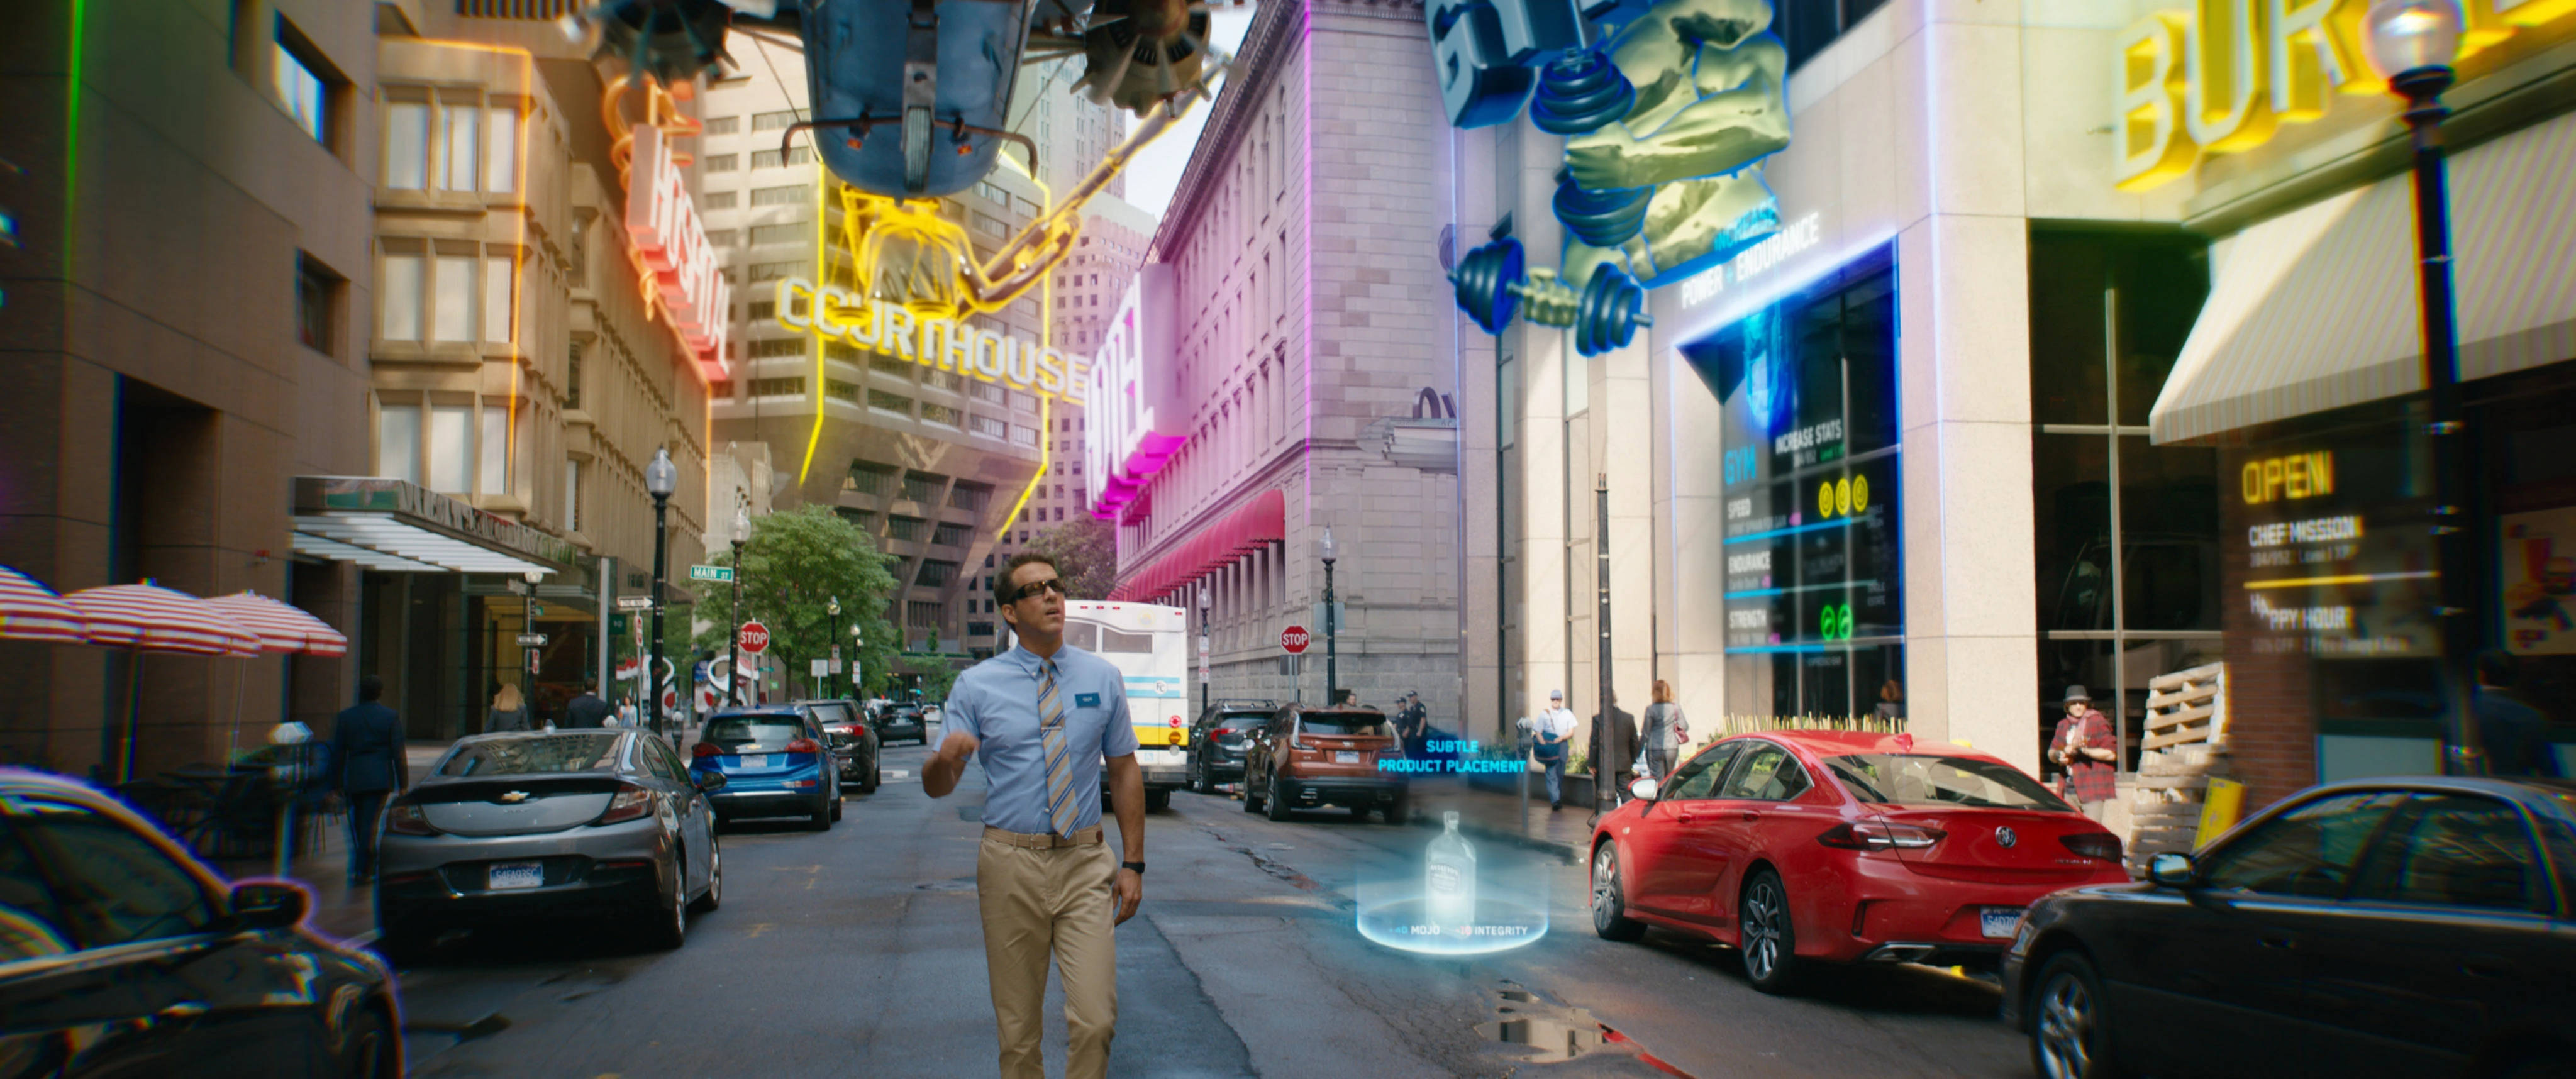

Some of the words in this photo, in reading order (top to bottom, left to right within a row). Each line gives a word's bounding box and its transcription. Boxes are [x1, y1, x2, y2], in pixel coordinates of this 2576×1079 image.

[649, 128, 730, 376] HOSPITAL
[1682, 264, 1723, 309] POWER
[1736, 212, 1819, 282] ENDURANCE
[1085, 269, 1155, 508] HOTEL
[1775, 426, 1814, 455] INCREASE
[1815, 419, 1842, 445] STATS
[1724, 443, 1757, 485] GYM
[2243, 451, 2332, 504] OPEN
[1728, 497, 1752, 520] SPEED
[2249, 524, 2285, 547] CHEF
[2290, 516, 2356, 543] MISSION
[694, 567, 717, 579] MAIN
[721, 572, 729, 580] ST
[1728, 550, 1771, 575] ENDURANCE
[2250, 592, 2299, 631] HAPPY
[2302, 607, 2351, 629] HOUR
[741, 631, 767, 645] STOP
[1282, 633, 1309, 646] STOP
[1426, 740, 1479, 753] SUBTLE
[1378, 759, 1442, 773] PRODUCT
[1446, 760, 1526, 773] PLACEMENT
[1411, 926, 1441, 936] MOJO
[1474, 926, 1528, 936] INTEGRITY
